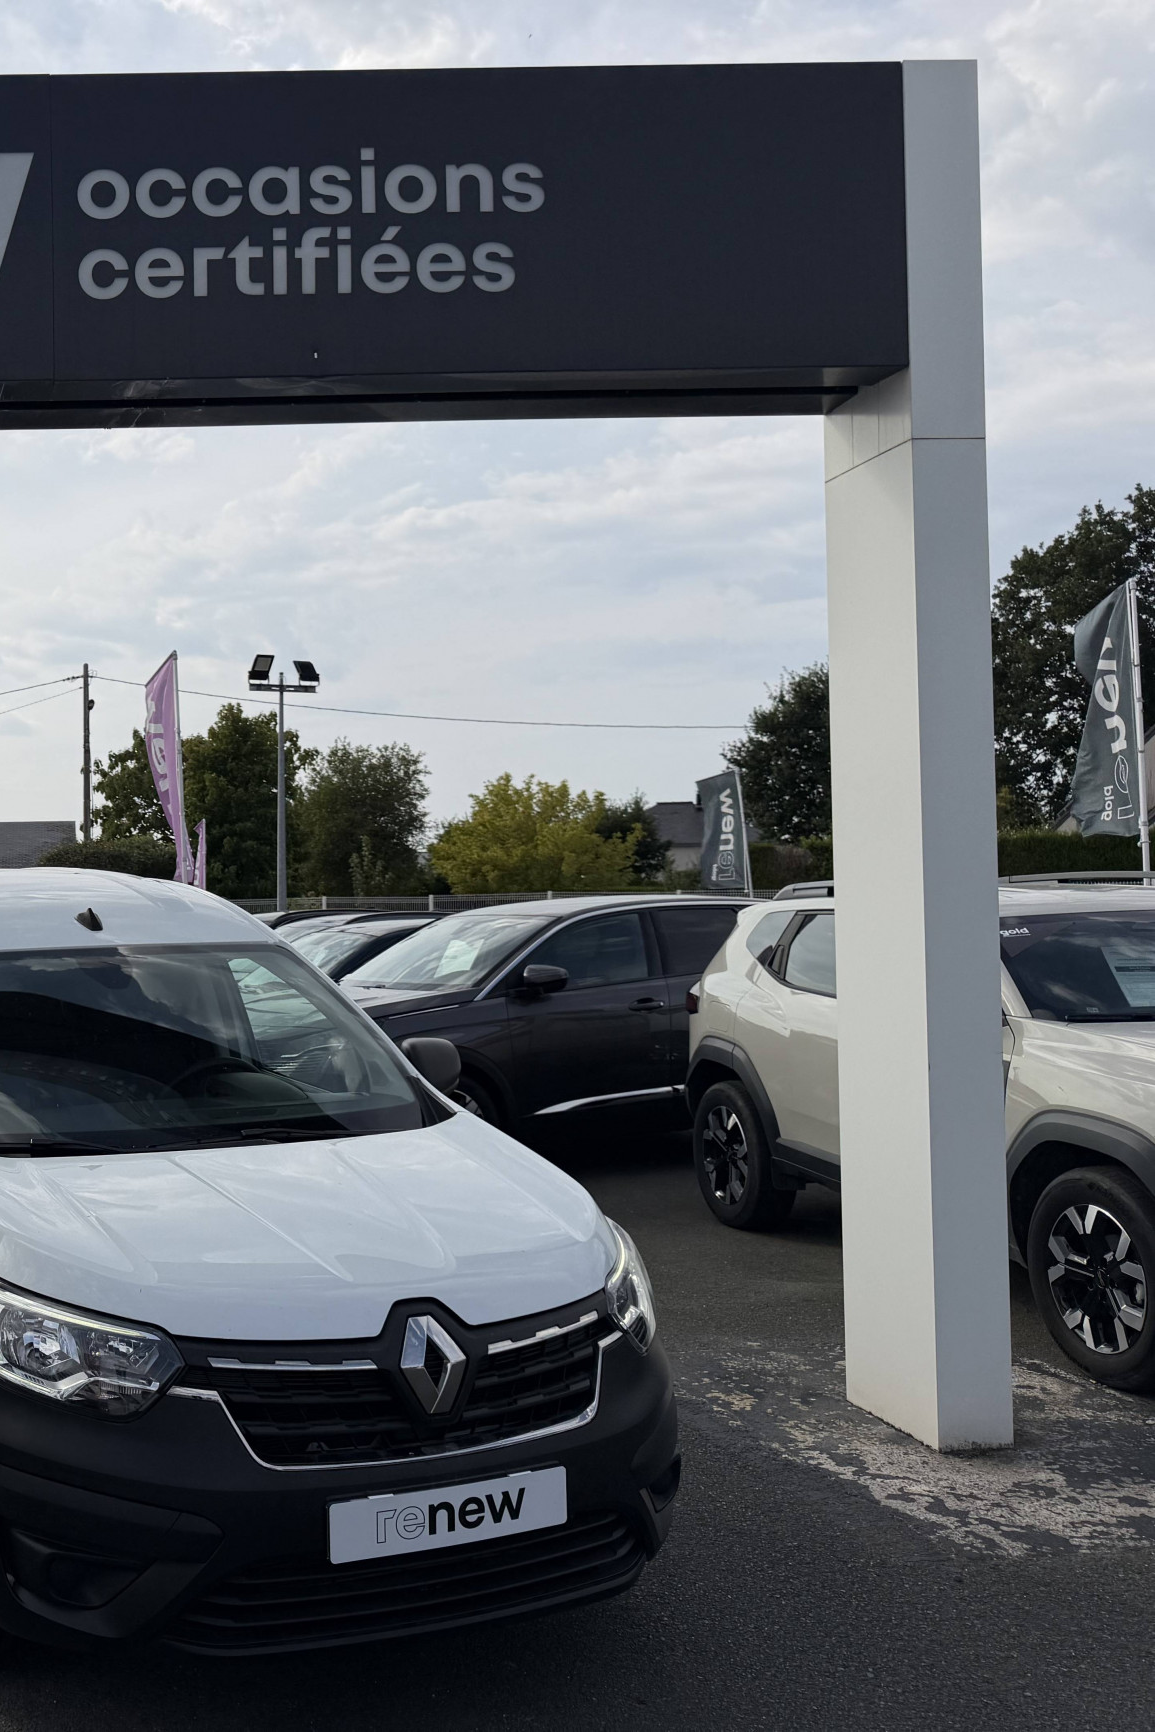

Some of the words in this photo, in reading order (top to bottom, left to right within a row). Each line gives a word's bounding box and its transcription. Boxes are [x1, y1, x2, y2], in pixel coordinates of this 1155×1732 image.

[76, 147, 546, 220] occasions
[77, 226, 516, 300] certifiées
[999, 927, 1030, 938] gold
[375, 1486, 526, 1544] renew
